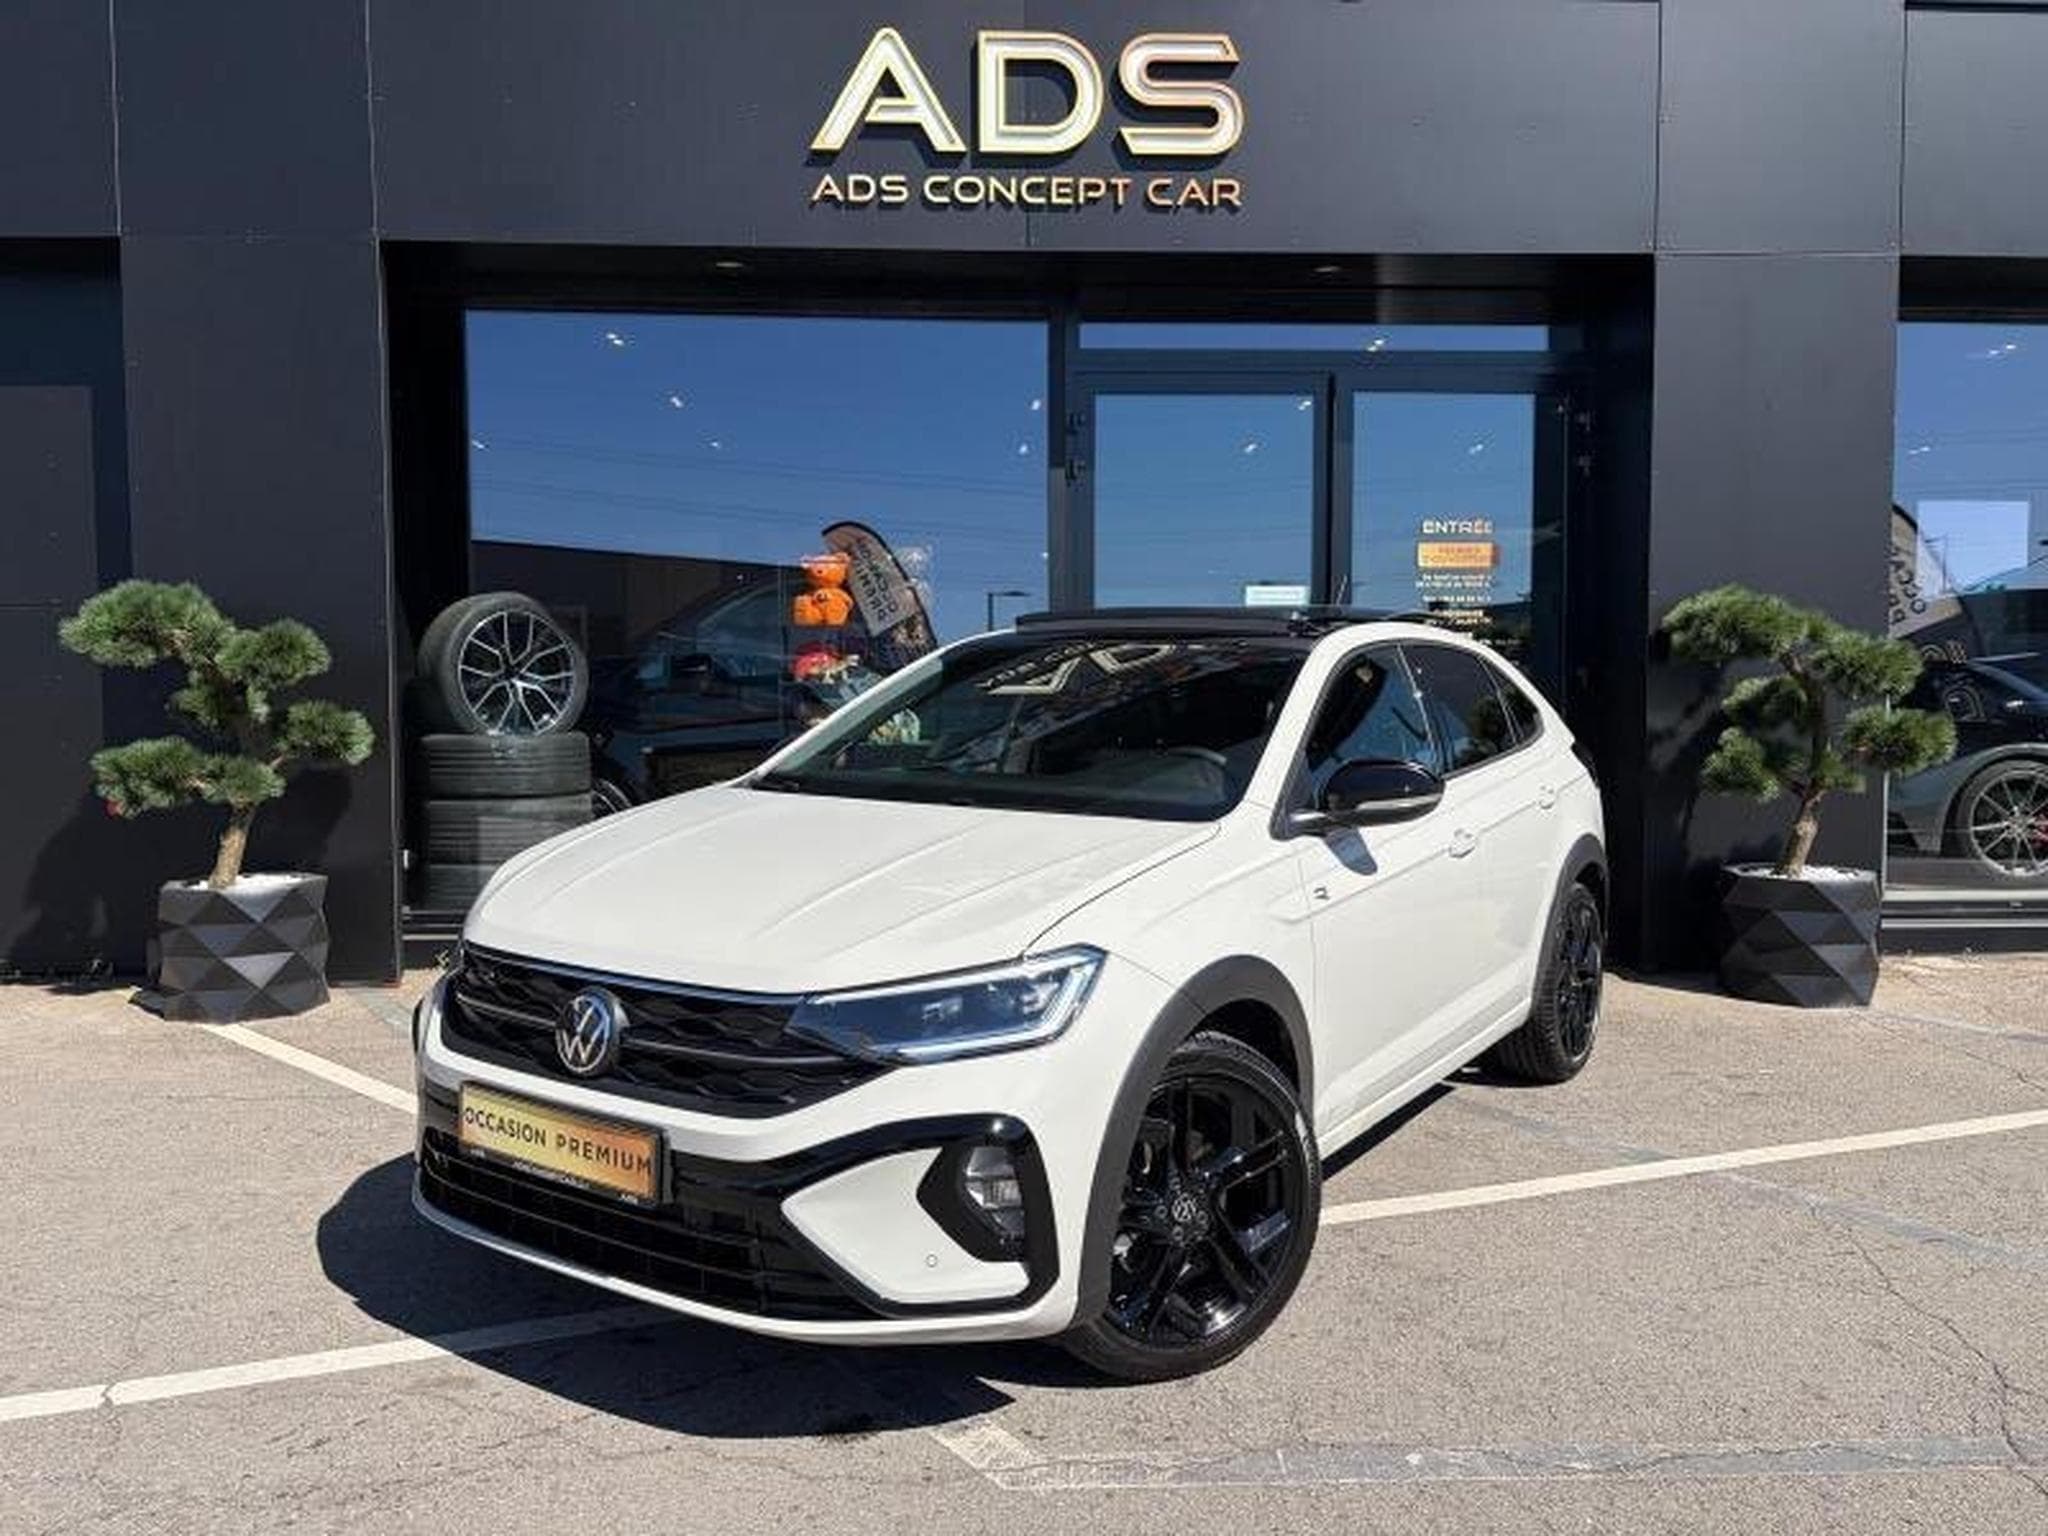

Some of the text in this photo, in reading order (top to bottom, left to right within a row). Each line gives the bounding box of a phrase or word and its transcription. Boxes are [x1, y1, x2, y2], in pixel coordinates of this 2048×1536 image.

[810, 27, 1245, 155] ADS
[811, 174, 1242, 206] ADS CONCEPT CAR
[462, 1106, 547, 1148] OCCASION
[555, 1132, 652, 1177] PREMIUM
